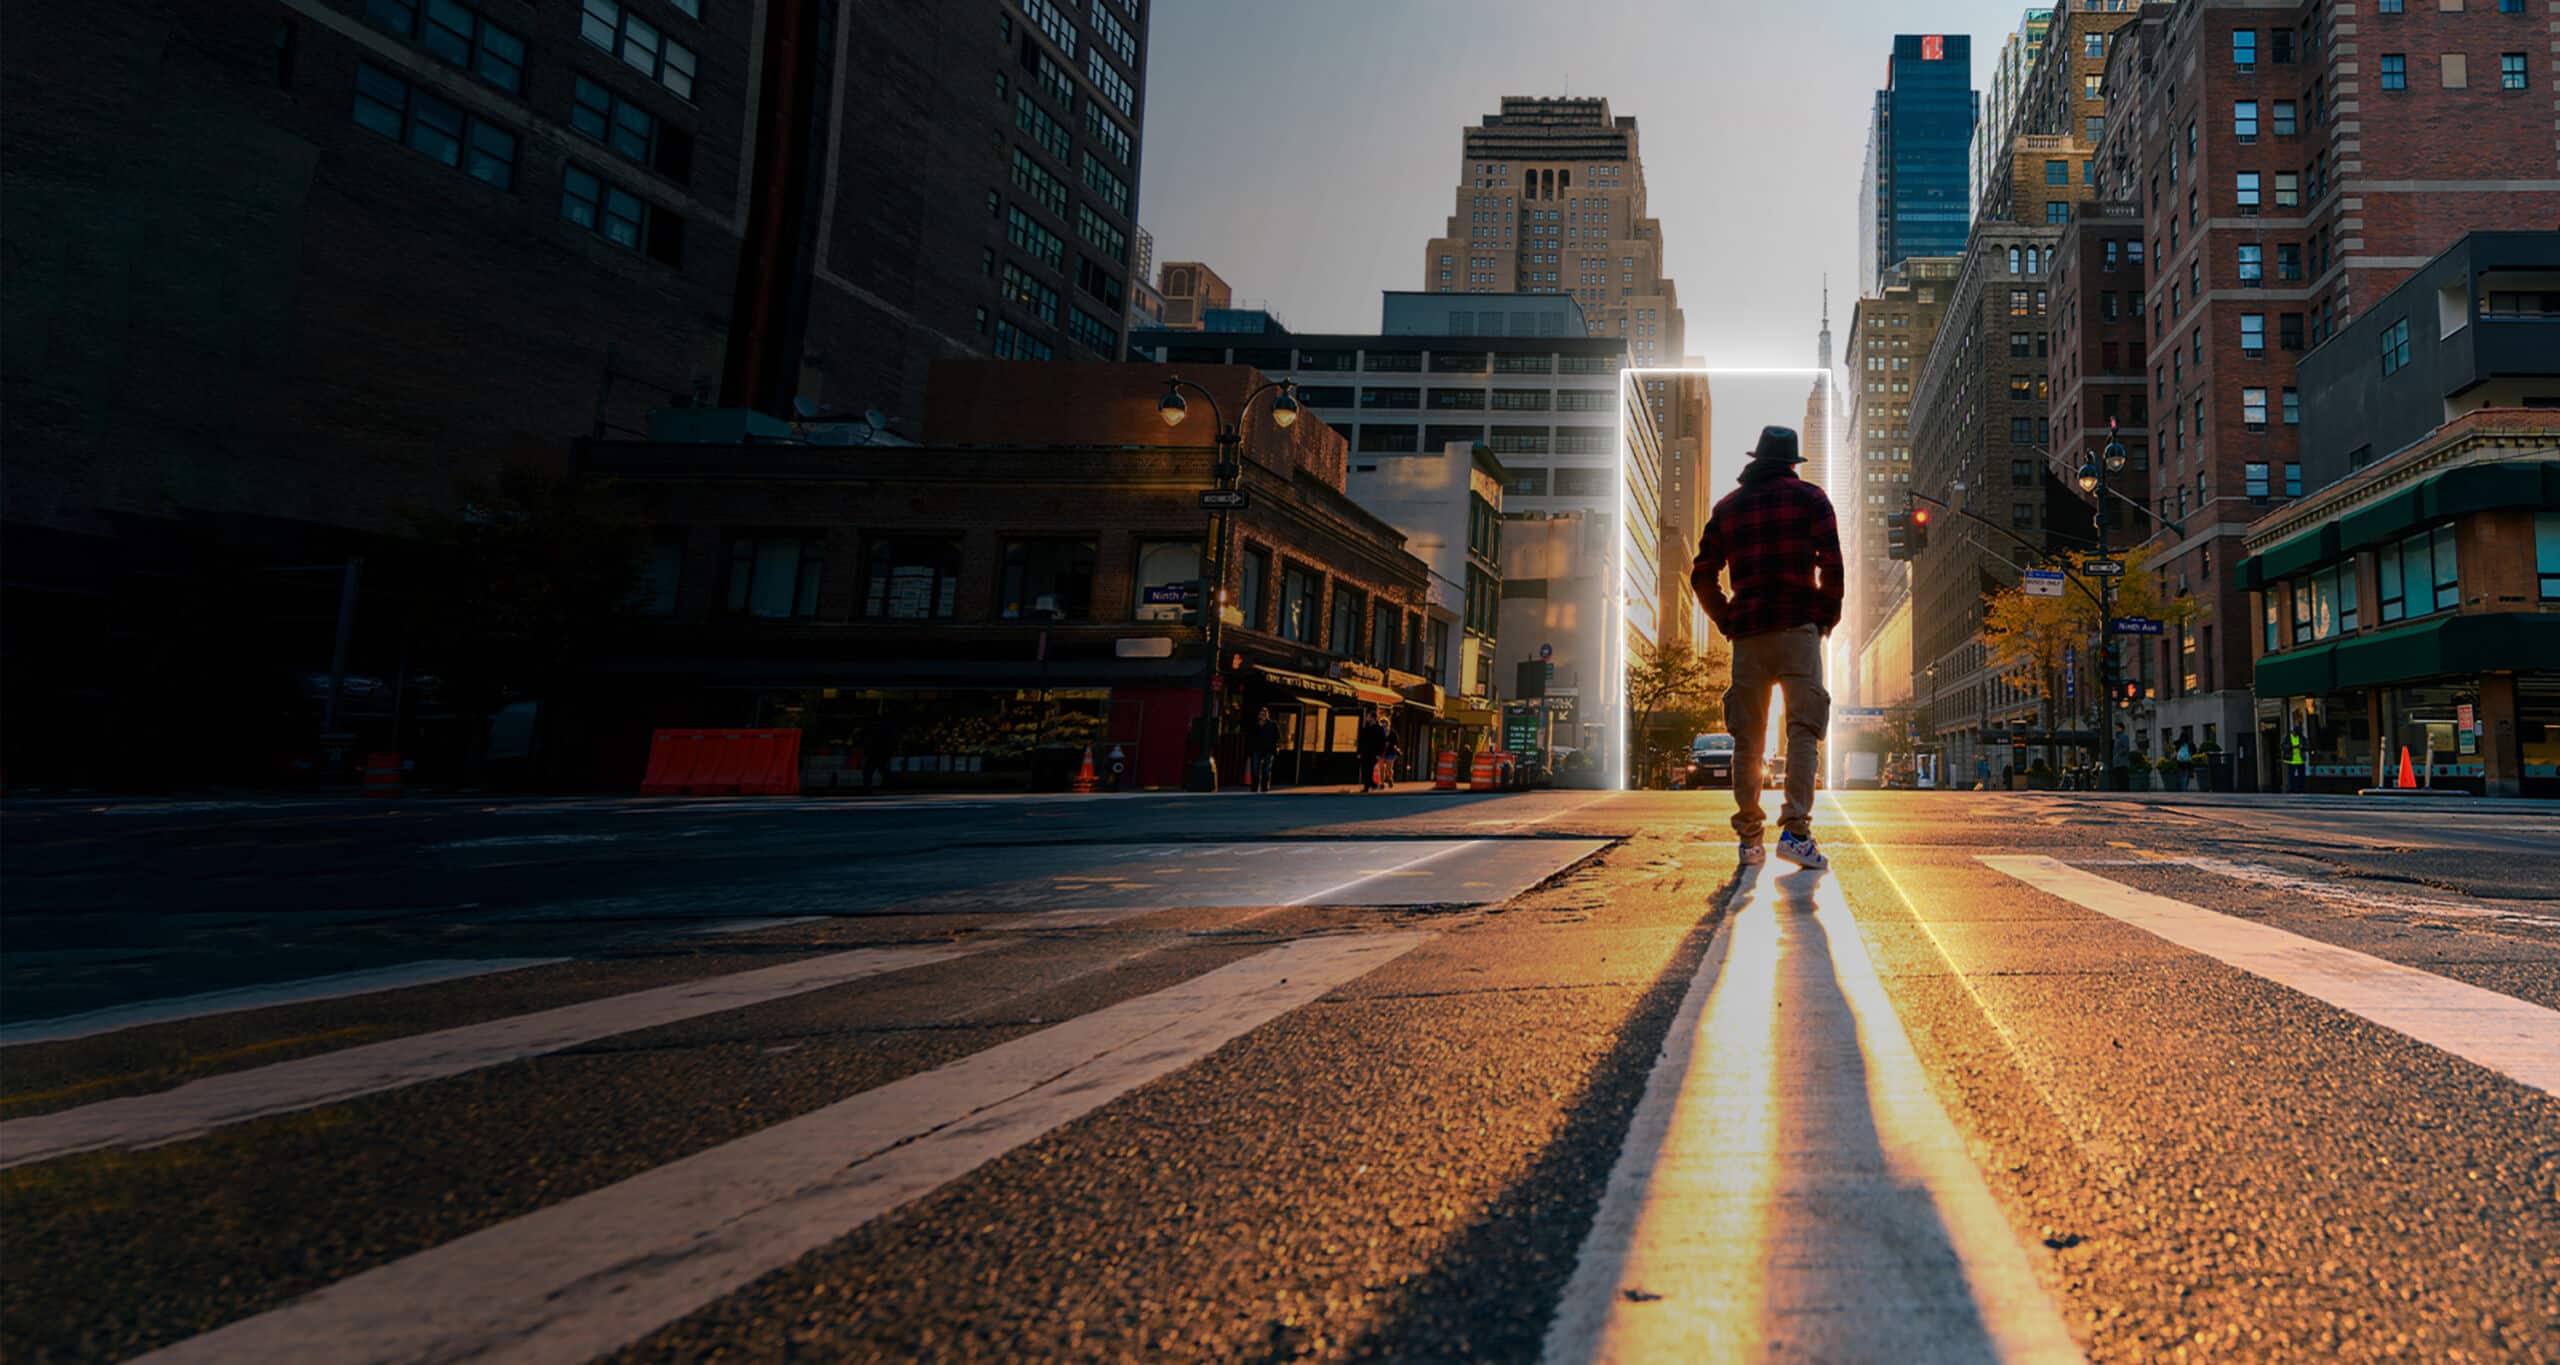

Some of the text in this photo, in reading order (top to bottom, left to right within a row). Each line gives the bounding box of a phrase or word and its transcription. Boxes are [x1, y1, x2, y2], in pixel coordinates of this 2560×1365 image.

[1152, 591, 1179, 601] Ninth
[2118, 622, 2157, 632] Ninth Ave
